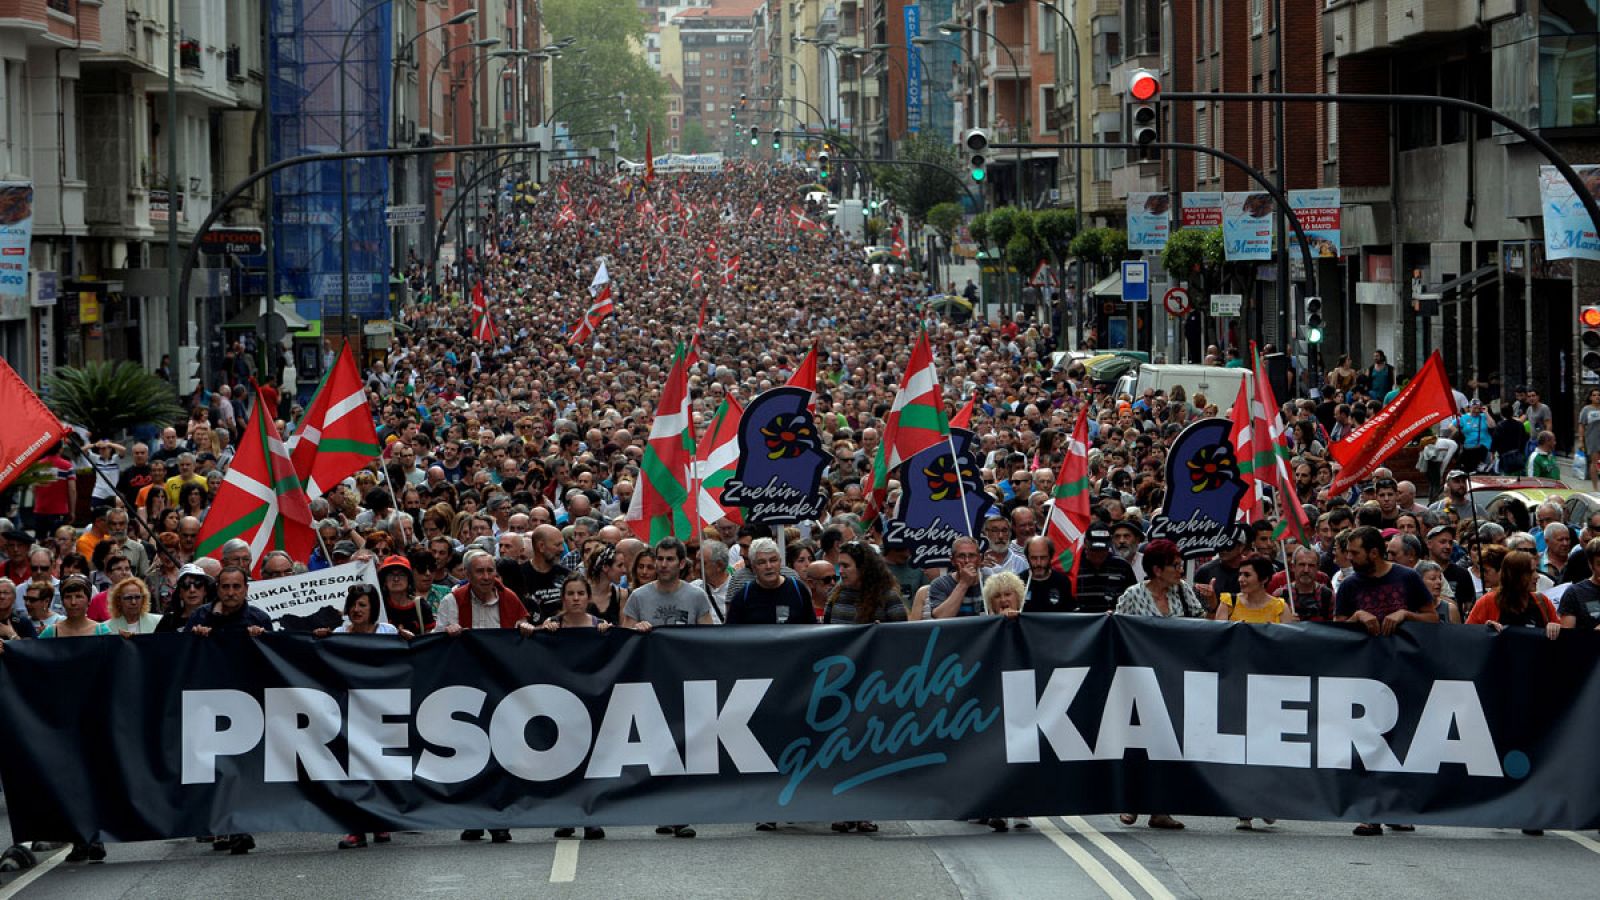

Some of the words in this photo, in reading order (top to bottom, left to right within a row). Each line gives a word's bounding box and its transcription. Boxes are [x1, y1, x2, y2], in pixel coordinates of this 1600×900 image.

[724, 475, 800, 501] Zuekin
[751, 495, 822, 521] gaude!
[887, 517, 962, 542] Zuekin
[1151, 508, 1218, 538] Zuekin
[292, 588, 317, 599] ETA
[300, 574, 364, 589] PRESOAK
[265, 591, 346, 613] IHESLARIAK
[805, 626, 981, 732] Bada
[181, 678, 779, 784] PRESOAK
[778, 686, 1000, 807] garaia
